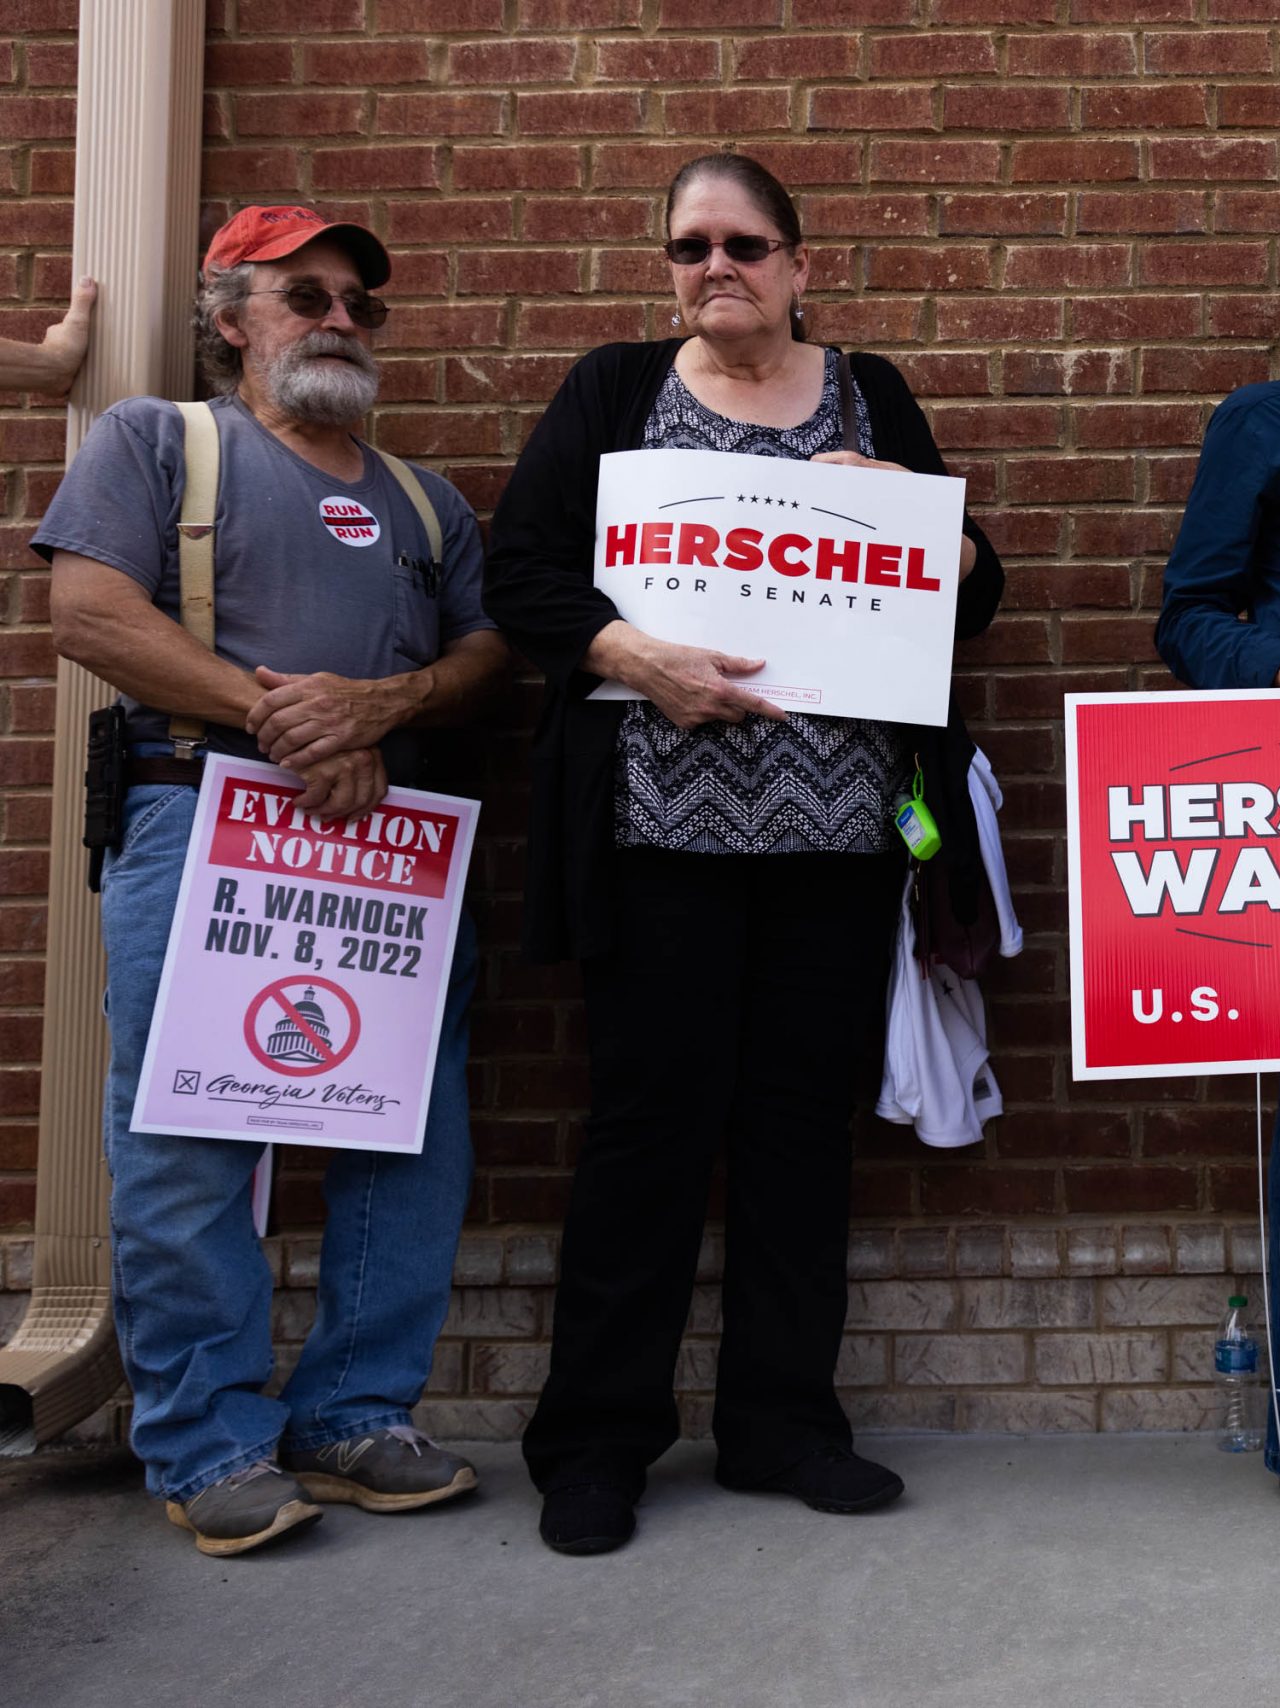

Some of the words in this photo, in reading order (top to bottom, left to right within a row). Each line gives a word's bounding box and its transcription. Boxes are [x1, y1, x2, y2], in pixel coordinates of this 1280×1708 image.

[323, 505, 363, 516] RUN
[334, 527, 374, 538] RUN
[605, 522, 941, 592] HERSCHEL
[644, 576, 706, 592] FOR
[740, 583, 882, 611] SENATE
[246, 830, 416, 885] NOTICE
[212, 877, 246, 915] R.
[264, 884, 428, 941] WARNOCK
[204, 918, 278, 959] NOV.
[293, 930, 323, 970] 8,
[337, 936, 422, 978] 2022
[1131, 985, 1239, 1025] U.S.
[206, 1074, 315, 1109] Georgia
[321, 1084, 400, 1111] Voters
